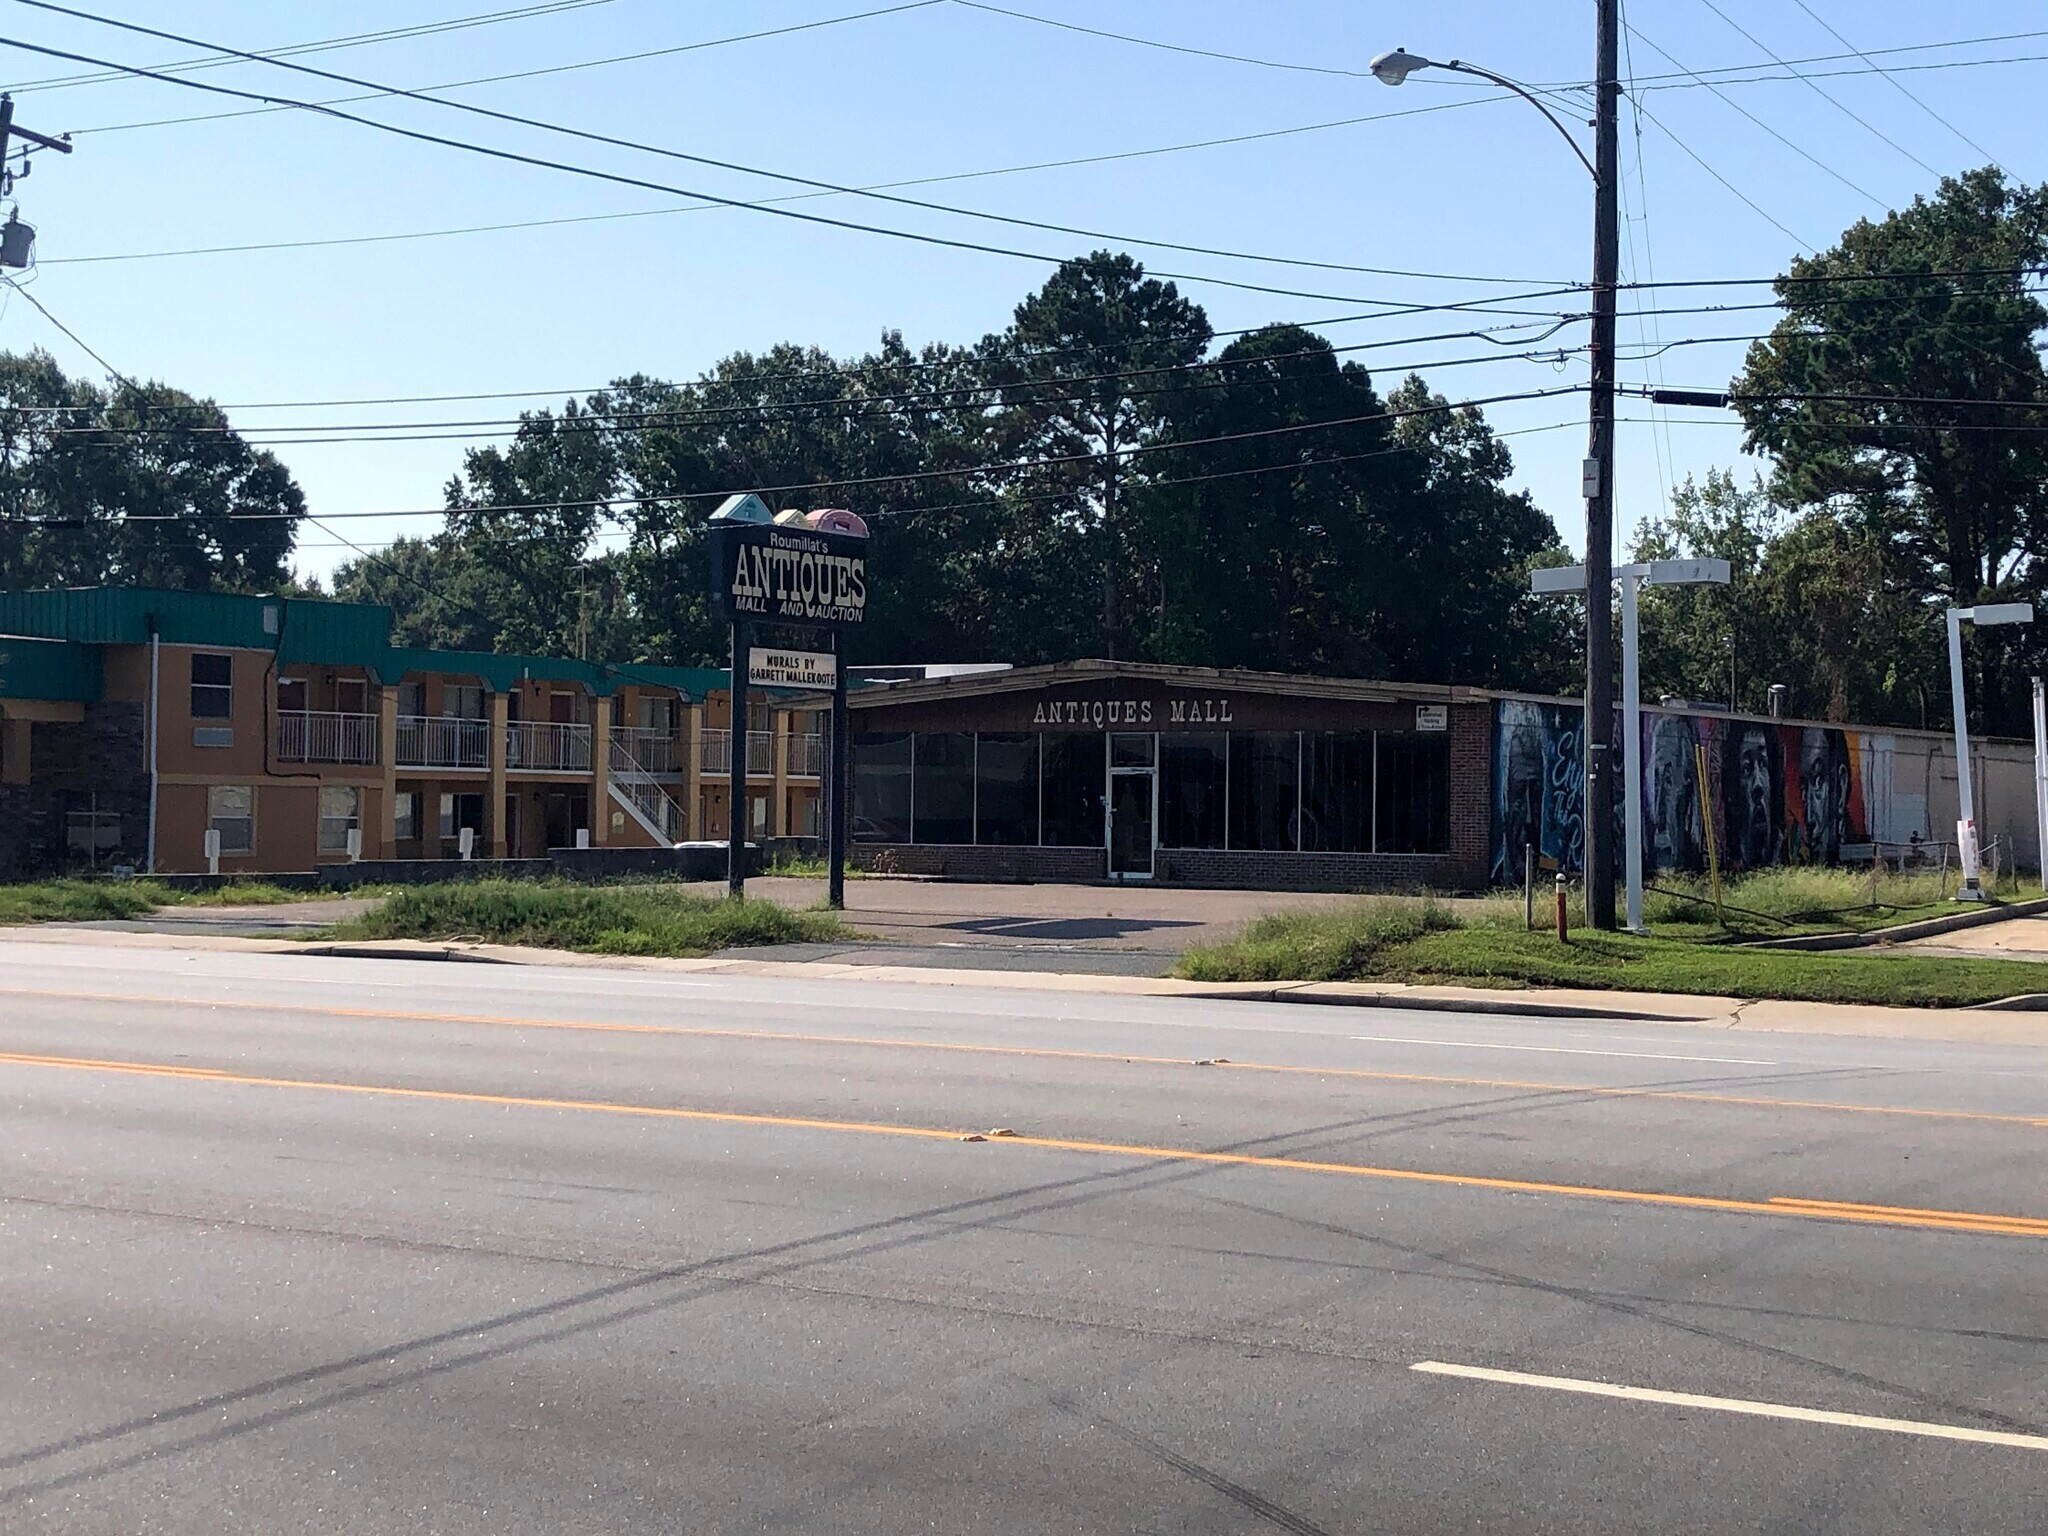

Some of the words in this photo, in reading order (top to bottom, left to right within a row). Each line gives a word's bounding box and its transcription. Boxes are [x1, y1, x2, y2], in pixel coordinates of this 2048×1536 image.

[770, 532, 829, 554] Roumillat's
[732, 544, 867, 618] ANTIQUES
[735, 596, 768, 613] MALL
[779, 601, 804, 616] AND
[814, 605, 863, 622] AUCTION
[766, 655, 800, 669] MURALS
[804, 658, 816, 669] BY
[750, 668, 785, 682] GARRETT
[1033, 701, 1153, 729] ANTIQUES
[1170, 700, 1233, 722] MALL
